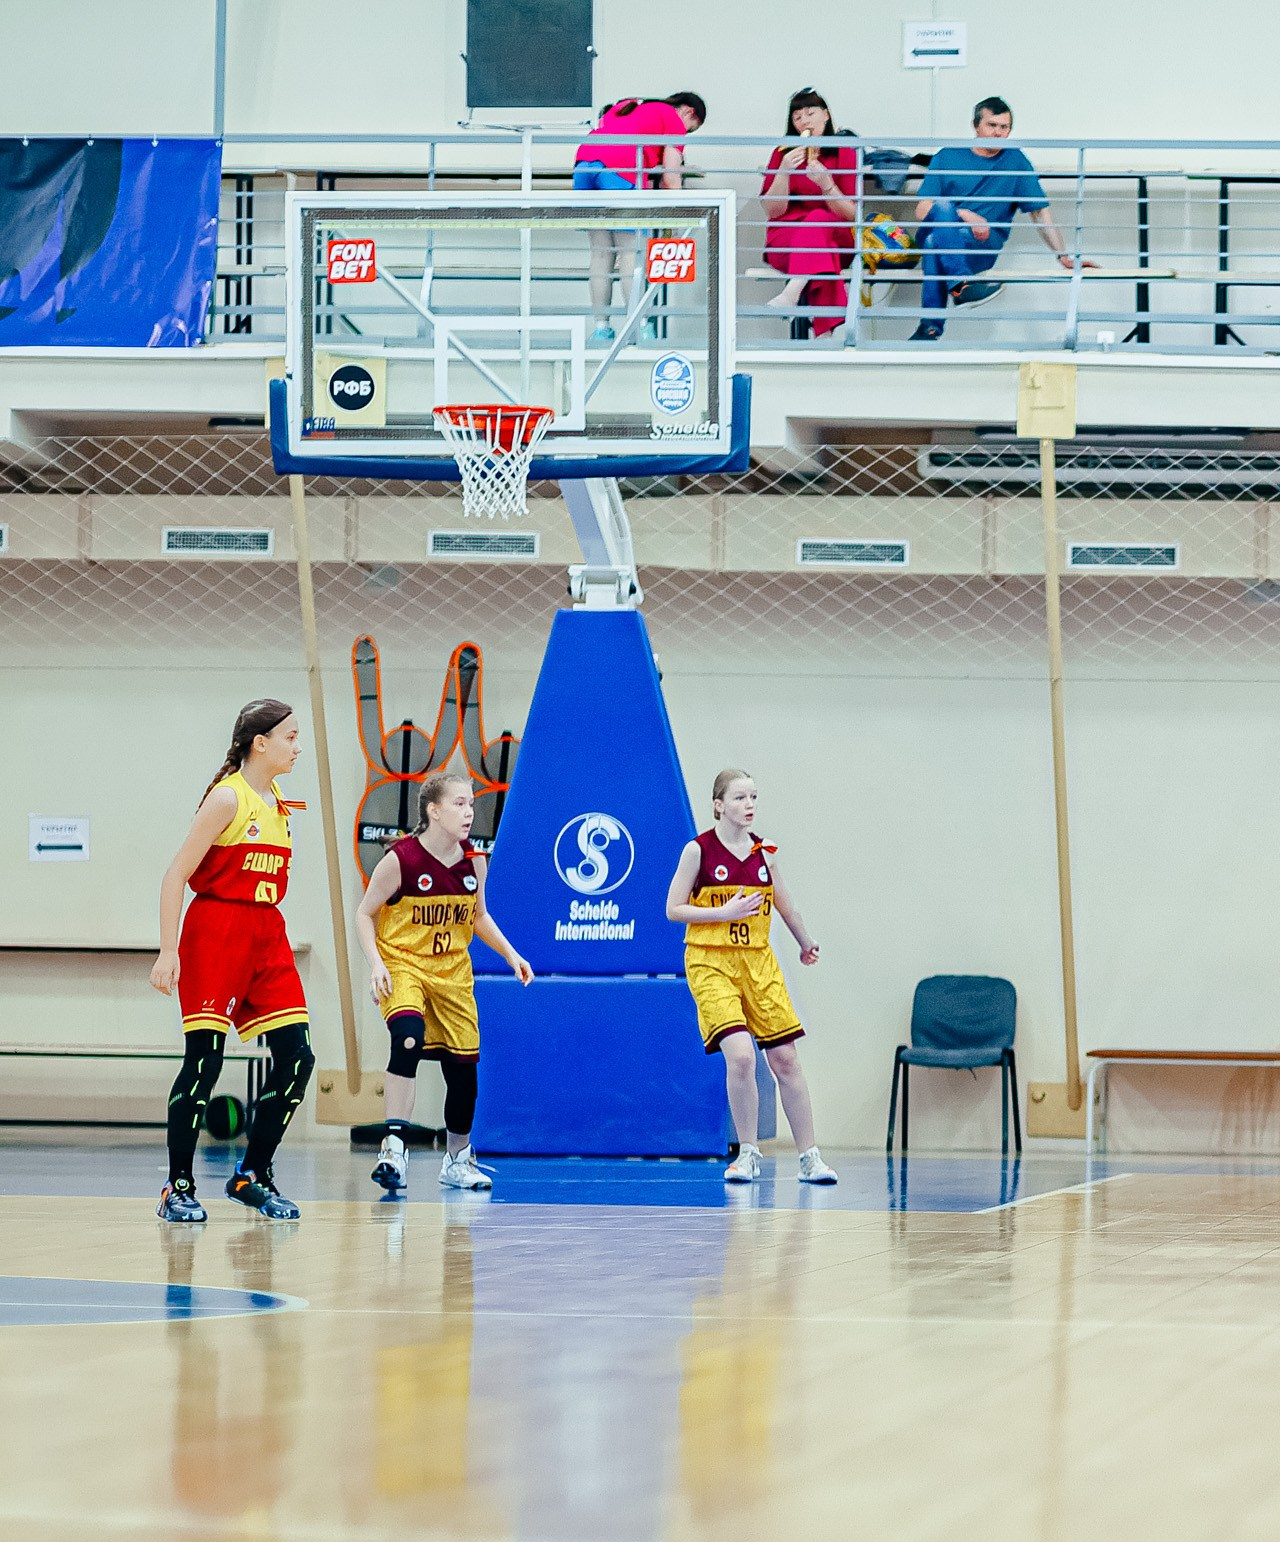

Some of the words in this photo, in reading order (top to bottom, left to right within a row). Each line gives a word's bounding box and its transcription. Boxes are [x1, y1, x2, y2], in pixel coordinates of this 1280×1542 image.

[329, 243, 373, 262] FON
[649, 242, 693, 261] FON
[329, 260, 373, 279] BET
[649, 260, 693, 278] BET
[333, 380, 372, 396] РФБ
[255, 880, 277, 904] 47
[412, 903, 452, 927] СШОР
[570, 899, 619, 921] Schelde
[763, 893, 772, 916] 5
[555, 919, 634, 941] International
[730, 922, 750, 945] 59
[433, 931, 451, 955] 62
